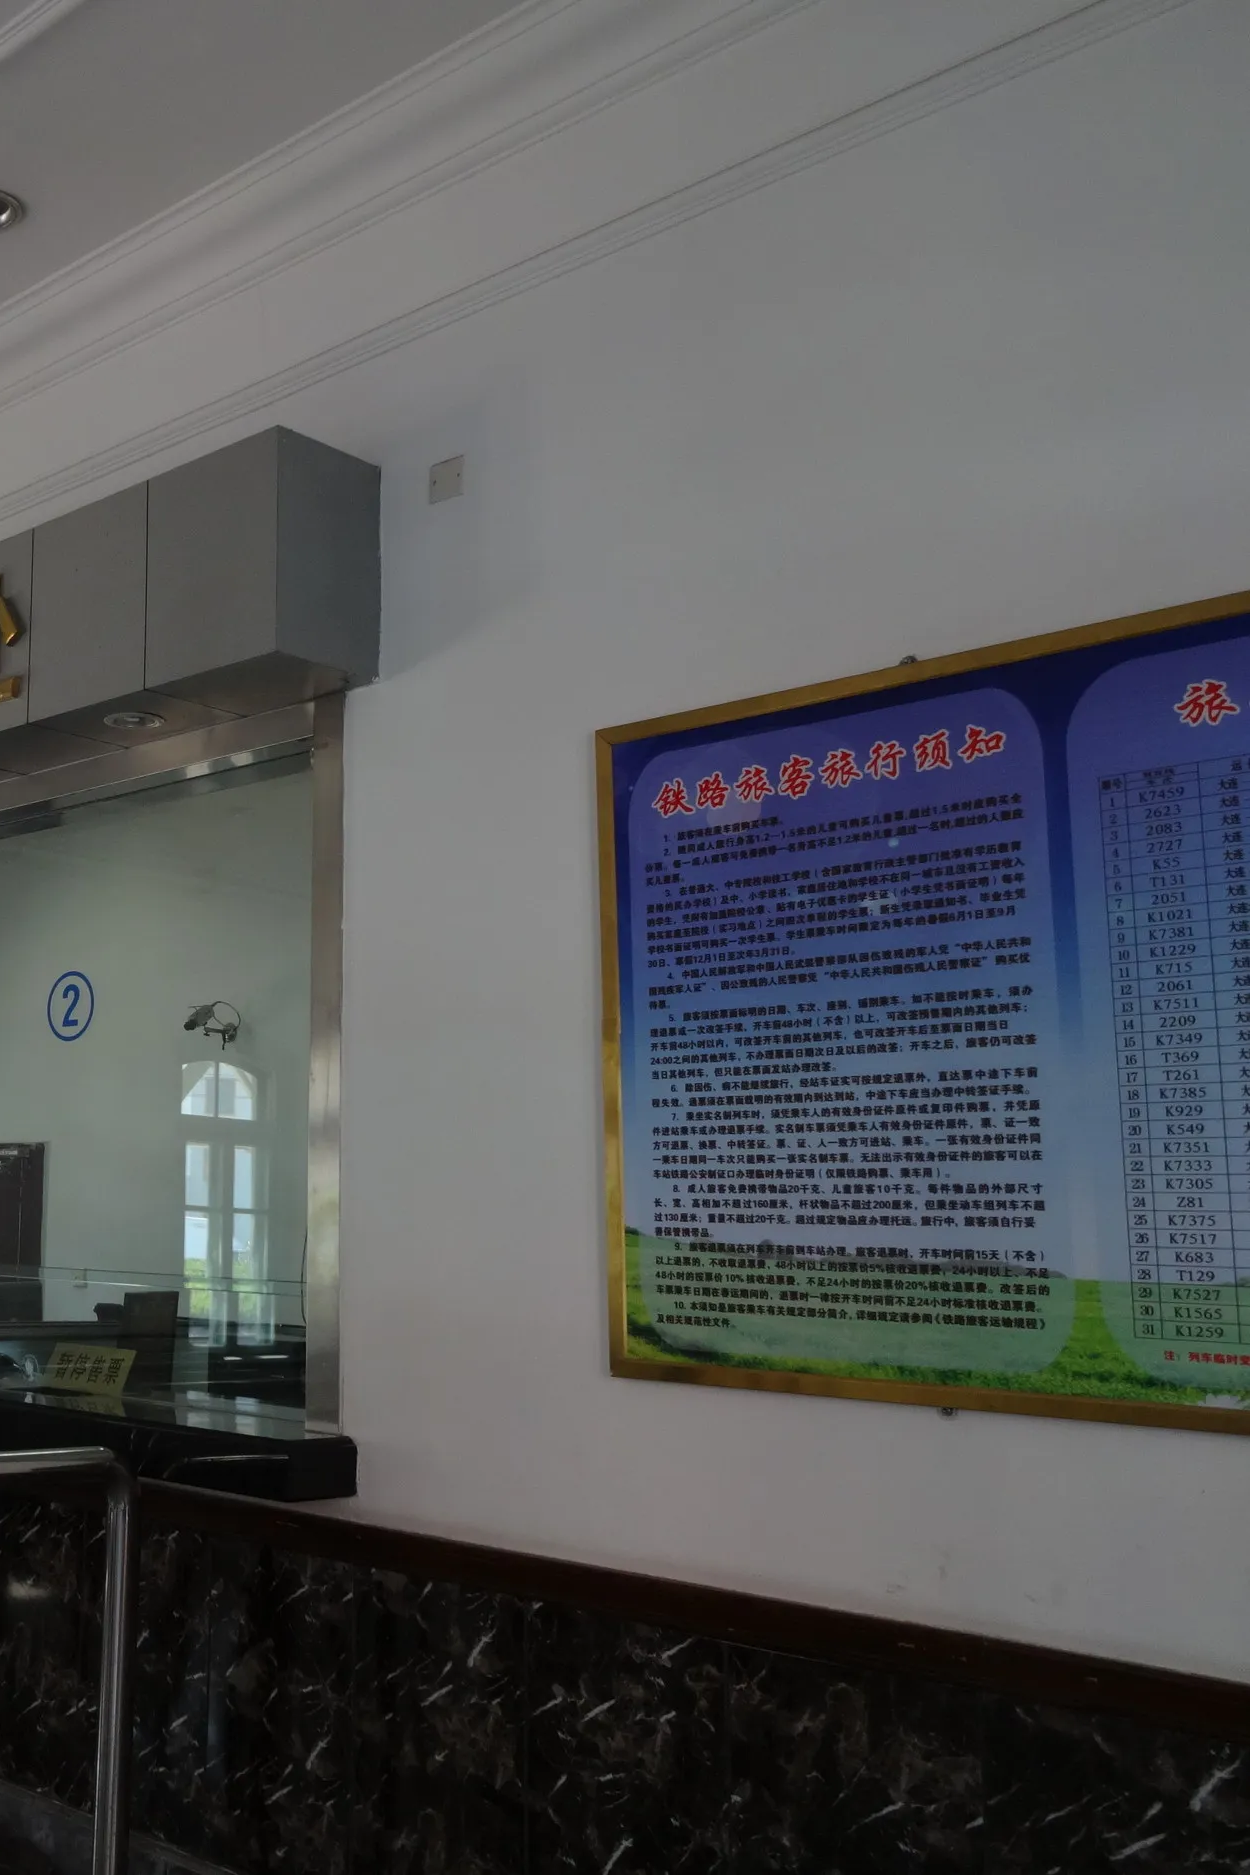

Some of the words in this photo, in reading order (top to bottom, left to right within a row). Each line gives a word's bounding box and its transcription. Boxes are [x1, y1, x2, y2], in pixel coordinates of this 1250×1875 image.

[651, 723, 1007, 817] 铁路旅客旅行须知
[1138, 786, 1185, 804] K7459
[1109, 797, 1115, 808] 1
[1145, 804, 1182, 820] 2623
[1109, 814, 1118, 824] 2
[1145, 822, 1183, 836] 2083
[1109, 830, 1118, 841] 3
[1146, 839, 1183, 854] 2727
[1112, 848, 1119, 858] 4
[1113, 864, 1121, 875] 5
[1152, 856, 1180, 871] K55
[1114, 881, 1122, 892] 6
[1149, 874, 1185, 888] T131
[1114, 898, 1123, 909] 7
[1151, 891, 1185, 905] 2051
[1116, 916, 1124, 926] 8
[1147, 909, 1192, 923] K1021
[1117, 933, 1125, 944] 9
[1149, 926, 1194, 940] K7381
[1118, 950, 1130, 961] 10
[1149, 944, 1196, 958] K1229
[1118, 967, 1131, 978] 11
[1155, 961, 1193, 975] K715
[1120, 984, 1133, 995] 12
[1157, 979, 1194, 992] 2061
[1121, 1002, 1134, 1013] 13
[1153, 997, 1198, 1011] K7511
[1122, 1020, 1134, 1031] 14
[1159, 1015, 1196, 1028] 2209
[1123, 1036, 1136, 1048] 15
[1155, 1032, 1203, 1047] K7349
[1125, 1054, 1138, 1066] 16
[1161, 1050, 1199, 1064] T369
[1126, 1072, 1138, 1083] 17
[1162, 1069, 1199, 1081] T261
[1127, 1090, 1140, 1101] 18
[1159, 1087, 1207, 1100] K7385
[1128, 1107, 1141, 1119] 19
[1165, 1105, 1204, 1118] K929
[1128, 1125, 1142, 1136] 20
[1166, 1123, 1205, 1135] K549
[1129, 1143, 1142, 1154] 21
[1163, 1142, 1210, 1154] K7351
[1130, 1161, 1144, 1172] 22
[1163, 1160, 1213, 1172] K7333
[1131, 1178, 1146, 1190] 23
[1165, 1178, 1213, 1190] K7305
[1132, 1196, 1146, 1208] 24
[1176, 1196, 1204, 1209] Z81
[1133, 1214, 1148, 1226] 25
[1167, 1214, 1216, 1227] K7375
[1134, 1232, 1149, 1244] 26
[1169, 1232, 1217, 1245] K7517
[1135, 1251, 1150, 1262] 27
[1174, 1251, 1214, 1263] K683
[1137, 1269, 1152, 1280] 28
[1175, 1270, 1215, 1282] T129
[1138, 1287, 1153, 1298] 29
[1172, 1288, 1221, 1302] K7527
[1140, 1305, 1154, 1317] 30
[1174, 1307, 1223, 1320] K1565
[1142, 1324, 1155, 1335] 31
[1175, 1325, 1224, 1338] K1259
